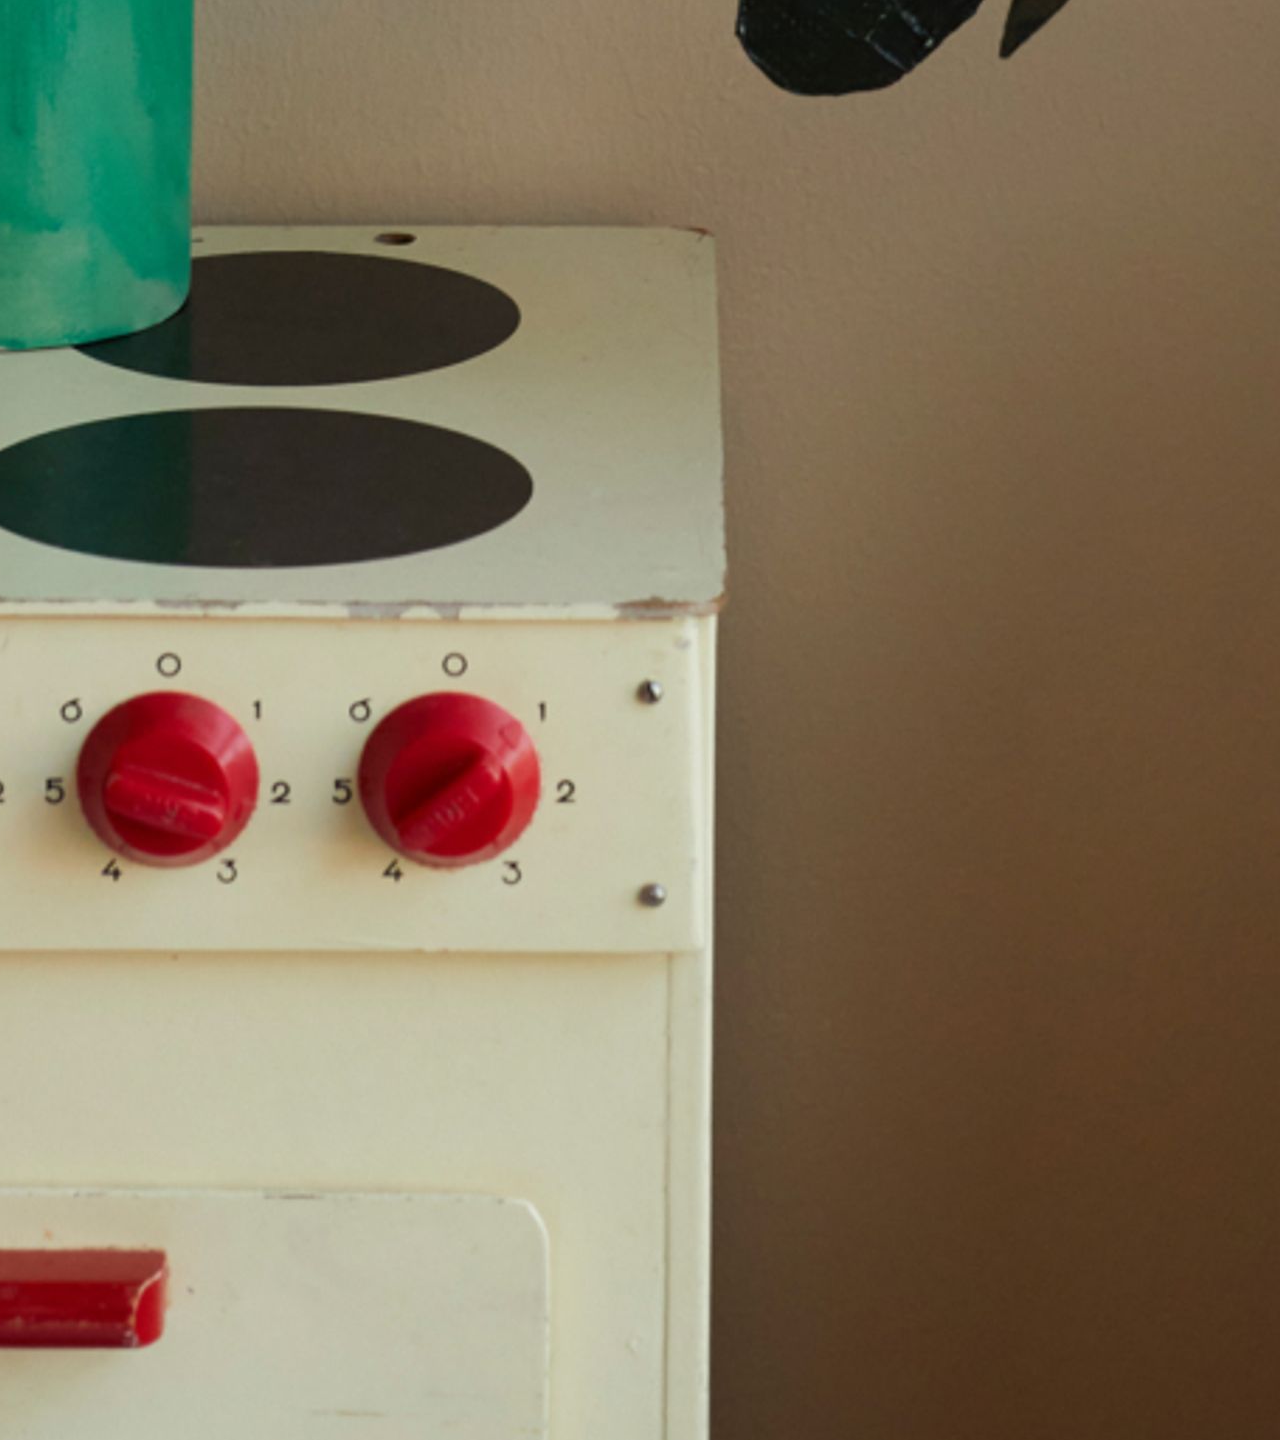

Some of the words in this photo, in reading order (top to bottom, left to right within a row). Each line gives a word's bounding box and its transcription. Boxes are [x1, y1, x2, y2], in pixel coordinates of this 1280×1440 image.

[44, 777, 65, 805] 5
[270, 780, 291, 805] 2
[332, 778, 353, 806] 5
[555, 778, 576, 804] 2
[101, 859, 122, 882] 4
[216, 858, 238, 885] 3
[382, 859, 404, 883] 4
[501, 860, 523, 886] 3
